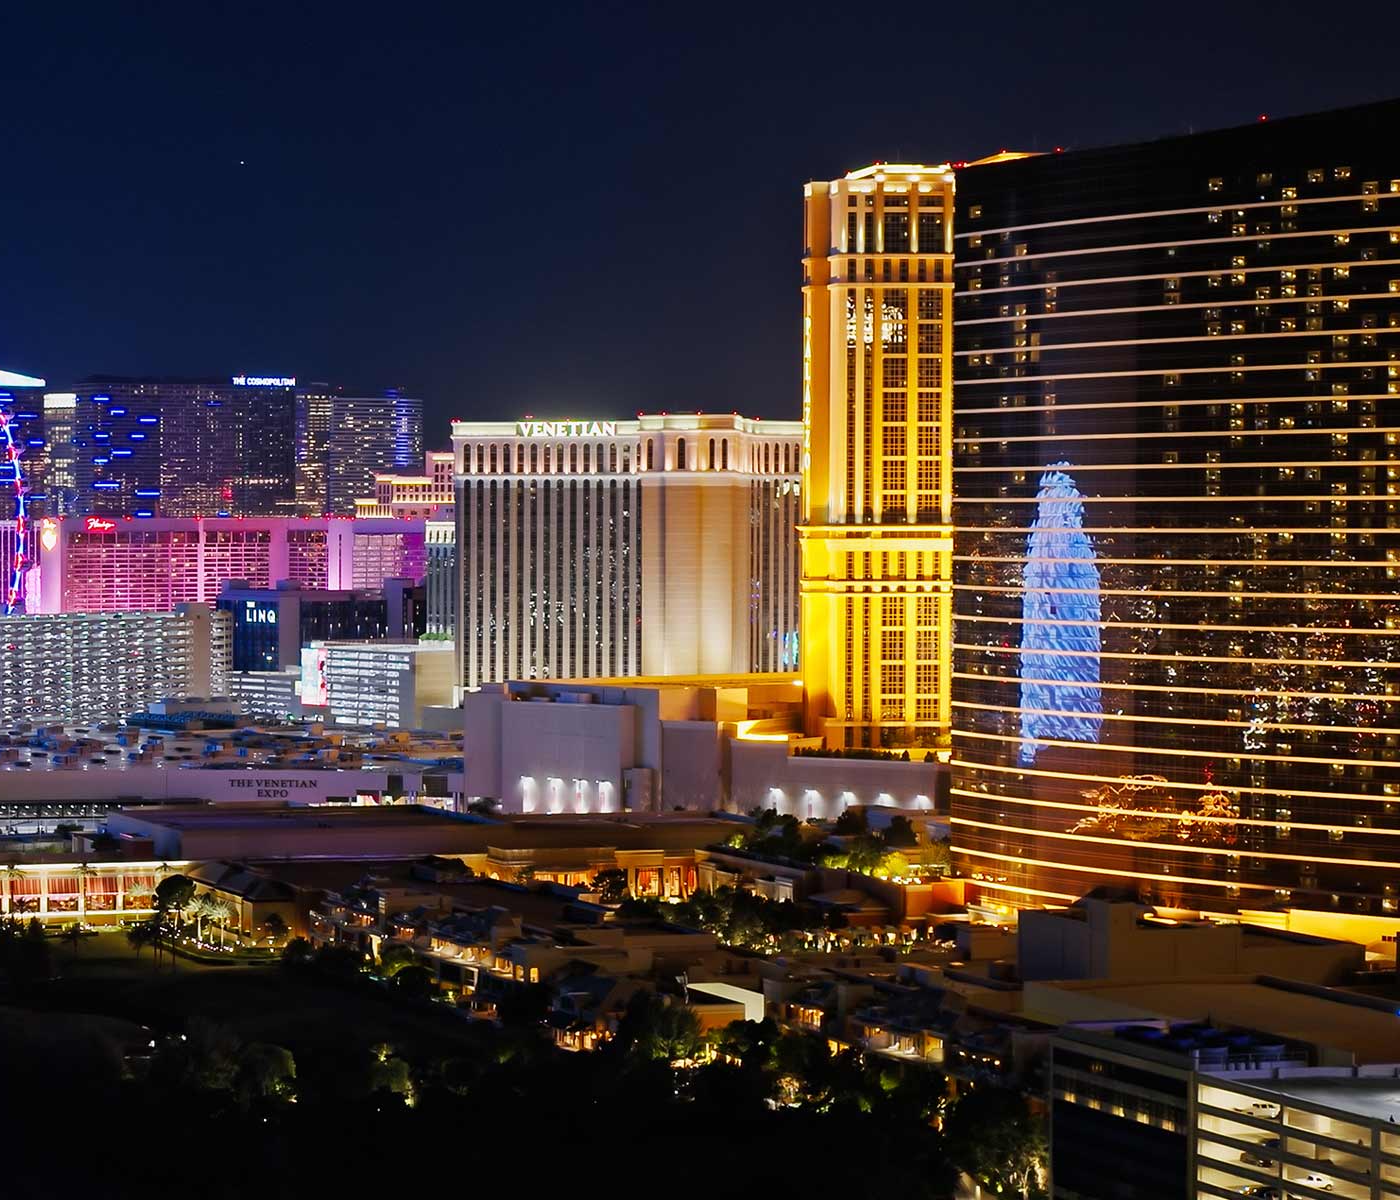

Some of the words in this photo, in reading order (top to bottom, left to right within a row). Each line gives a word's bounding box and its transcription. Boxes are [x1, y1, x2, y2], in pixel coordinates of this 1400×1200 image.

[232, 377, 246, 386] THE
[246, 377, 296, 387] COSMOPOLITAN
[517, 420, 617, 437] VENETIAN
[246, 609, 276, 623] LINQ
[229, 778, 254, 788] THE
[255, 778, 318, 789] VENETIAN
[257, 788, 289, 798] EXPO
